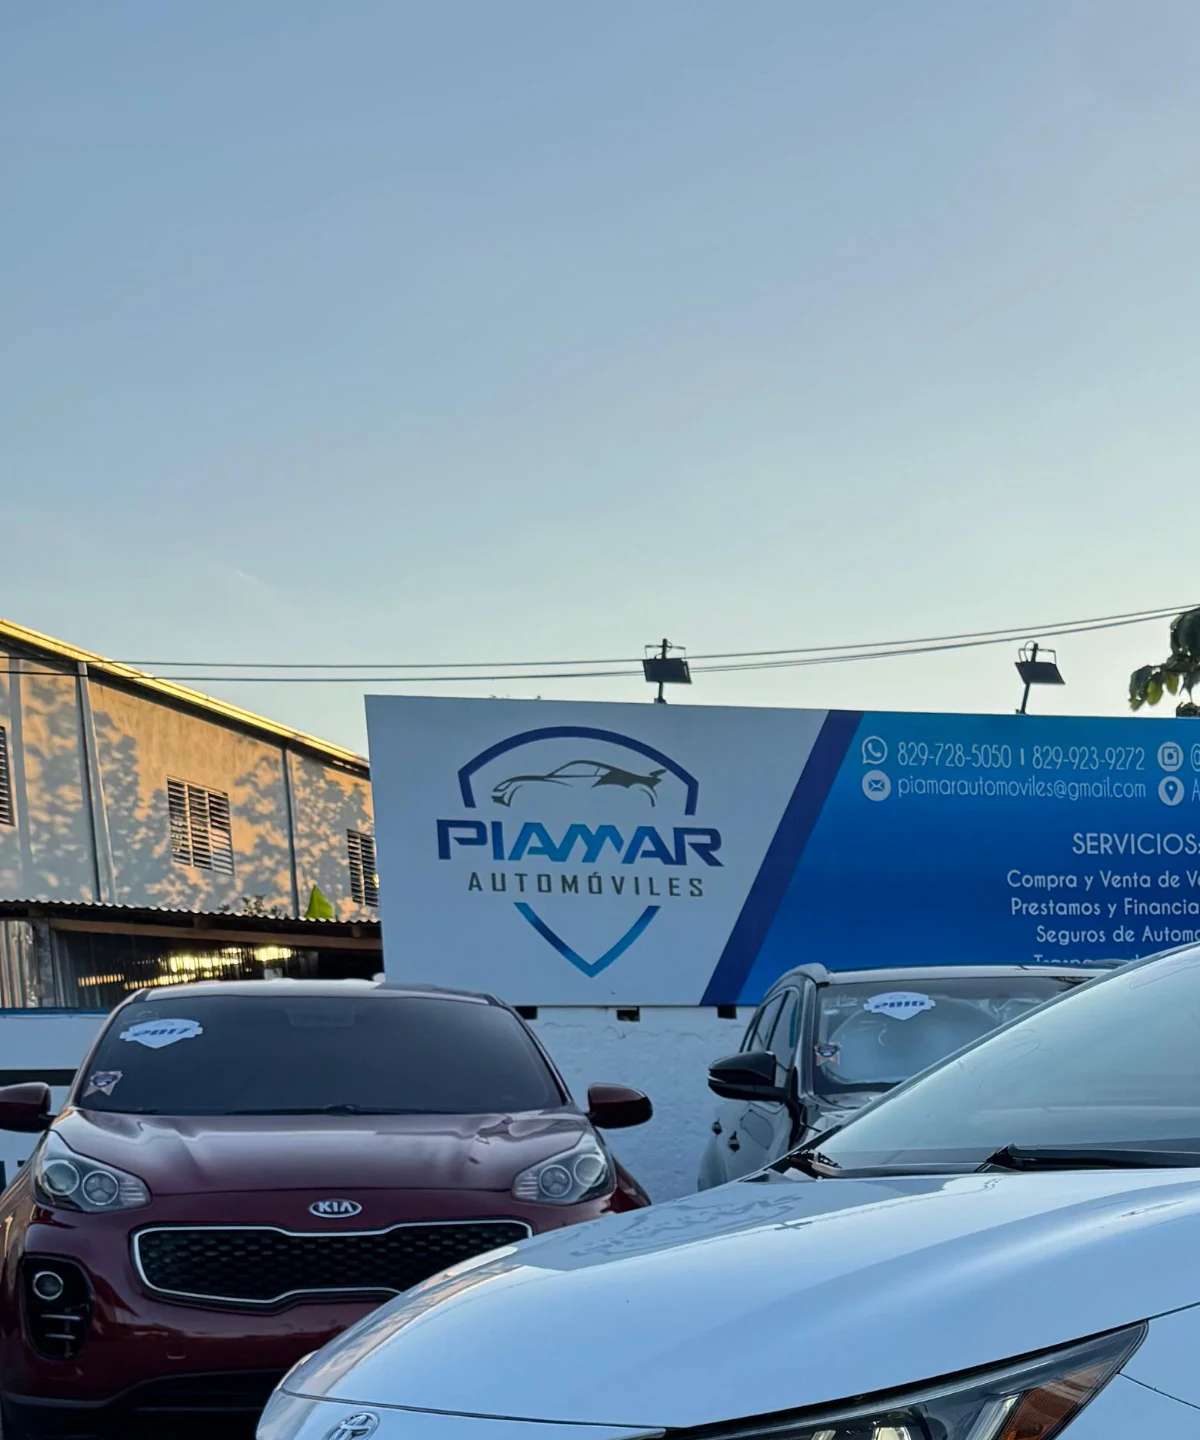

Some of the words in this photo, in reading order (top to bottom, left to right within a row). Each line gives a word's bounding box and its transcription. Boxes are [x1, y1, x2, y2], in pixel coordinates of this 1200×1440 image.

[897, 742, 1012, 768] 829-728-5050
[1032, 746, 1145, 771] 829-923-9272
[898, 776, 1147, 801] piamarautomoviles@gmail.com
[436, 819, 724, 867] PIAMAR
[468, 872, 704, 898] AUTOMÓVILES
[1007, 870, 1077, 891] Compra
[1084, 874, 1094, 891] y
[1100, 870, 1151, 888] Venta
[1158, 870, 1180, 888] de
[1011, 898, 1101, 915] Prestamos
[1107, 902, 1117, 918] y
[1036, 925, 1106, 945] Seguros
[1113, 925, 1135, 943] de
[319, 1201, 354, 1212] KIA
